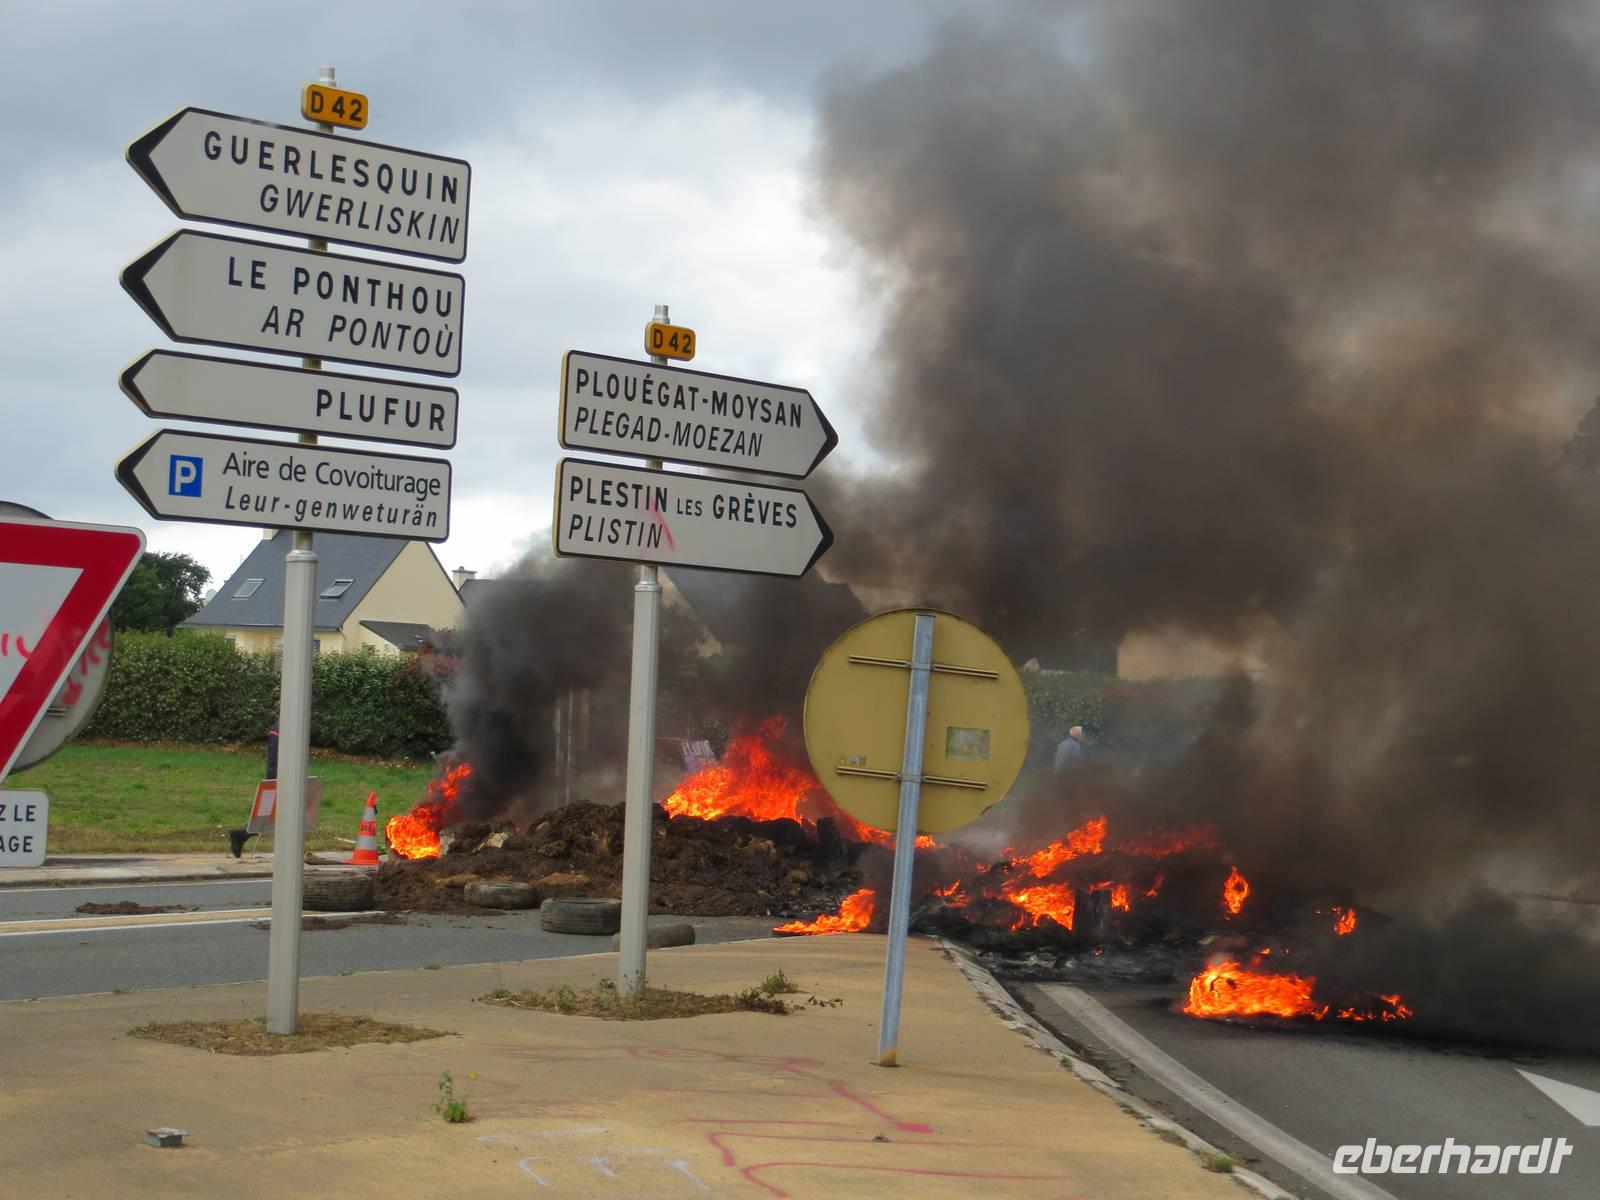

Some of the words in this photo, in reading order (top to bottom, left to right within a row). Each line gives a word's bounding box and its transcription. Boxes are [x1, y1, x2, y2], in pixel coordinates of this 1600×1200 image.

[311, 91, 324, 114] D
[332, 96, 363, 122] 42
[204, 131, 457, 204] GUERLESQUIN
[260, 184, 459, 244] GWERLISKIN
[228, 256, 266, 290] LE
[293, 267, 452, 317] PONTHOU
[261, 305, 304, 338] AR
[328, 314, 453, 358] PONTOÙ
[653, 328, 664, 349] D
[669, 332, 692, 354] 42
[316, 388, 446, 431] PLUFUR
[576, 367, 801, 428] PLOUÉGAT-MOYSAN
[574, 406, 762, 457] PLEGAD-MOEZAN
[174, 460, 197, 493] P
[222, 451, 270, 479] Aire
[279, 456, 307, 482] de
[315, 462, 441, 501] Covoiturage
[224, 486, 437, 527] Leur-genweturän
[570, 476, 668, 512] PLESTIN
[677, 498, 703, 517] LES
[713, 493, 798, 528] GRÈVES
[569, 514, 662, 548] PLISTIN
[14, 804, 37, 822] LE
